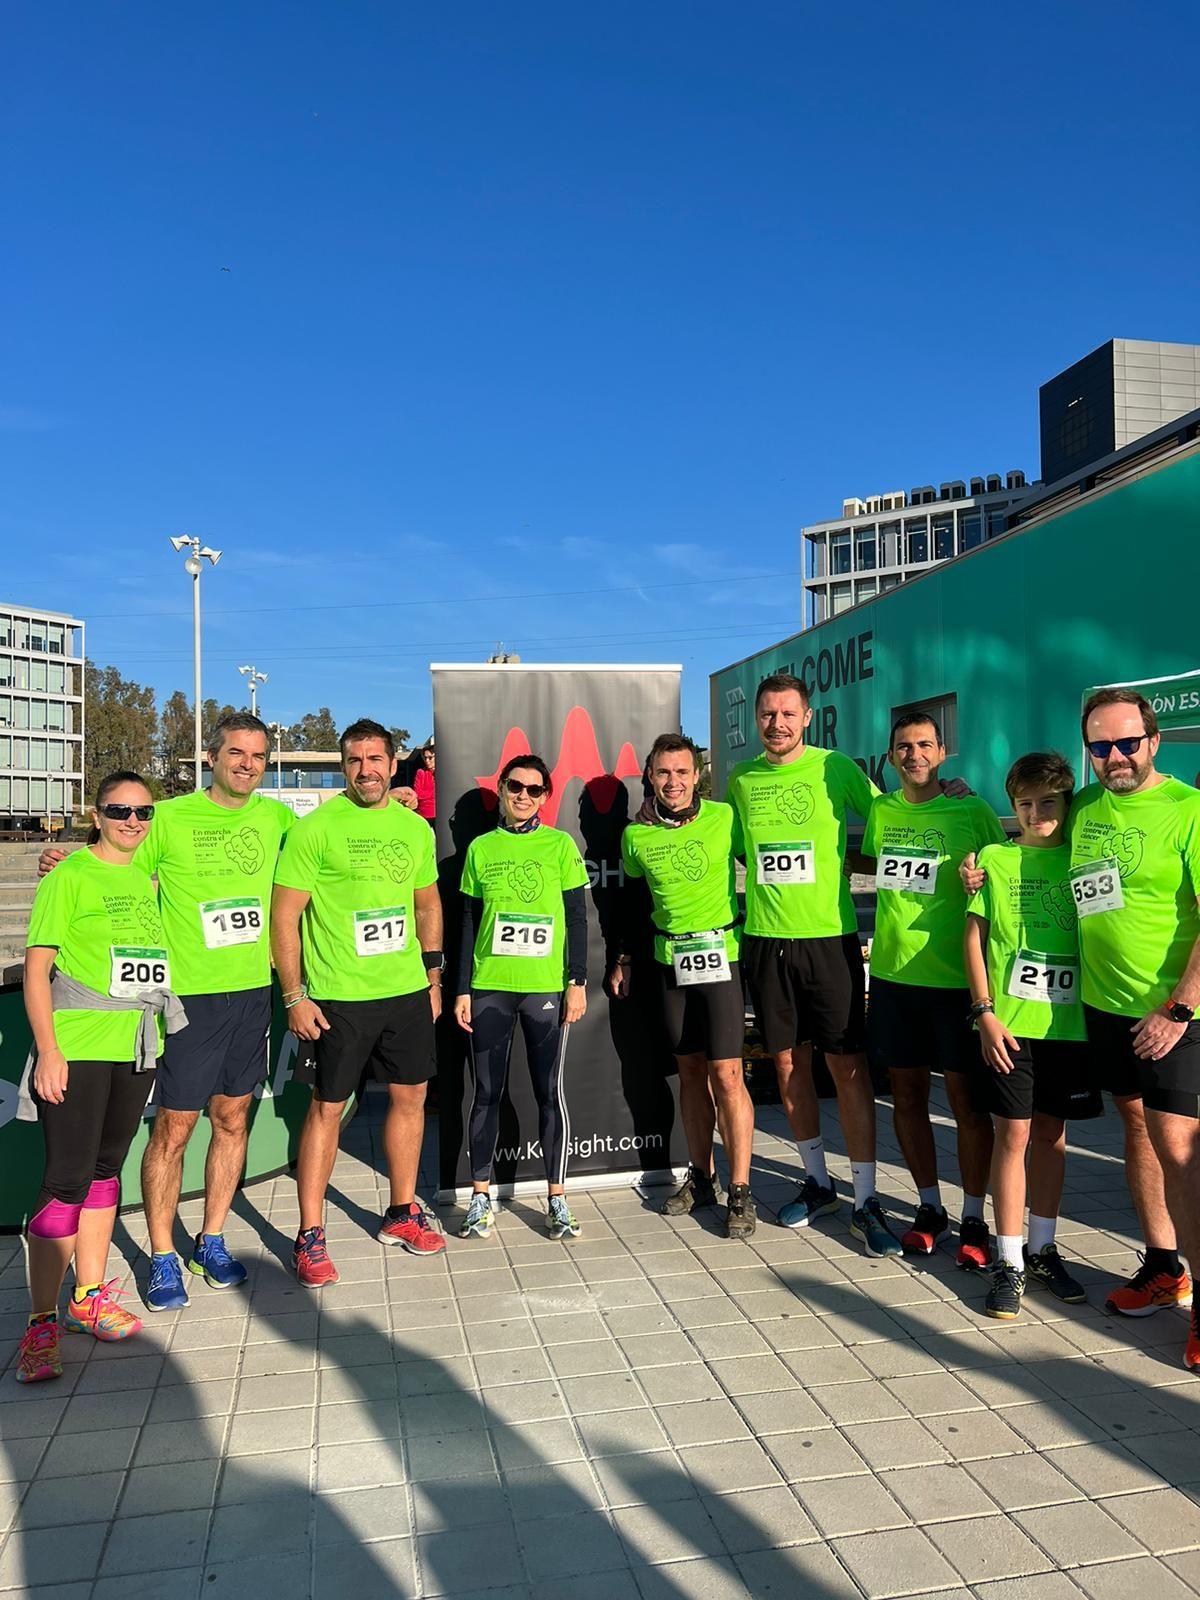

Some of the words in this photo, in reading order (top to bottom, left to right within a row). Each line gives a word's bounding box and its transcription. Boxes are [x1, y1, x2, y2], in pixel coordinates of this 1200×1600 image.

[761, 631, 874, 698] COME
[1179, 691, 1200, 710] ES
[803, 705, 838, 747] UR
[763, 854, 806, 872] 201
[884, 859, 930, 880] 214
[1073, 875, 1114, 902] 533
[212, 911, 261, 932] 198
[363, 919, 404, 942] 217
[501, 926, 547, 944] 216
[120, 962, 165, 983] 206
[679, 953, 722, 971] 499
[1020, 965, 1074, 990] 210
